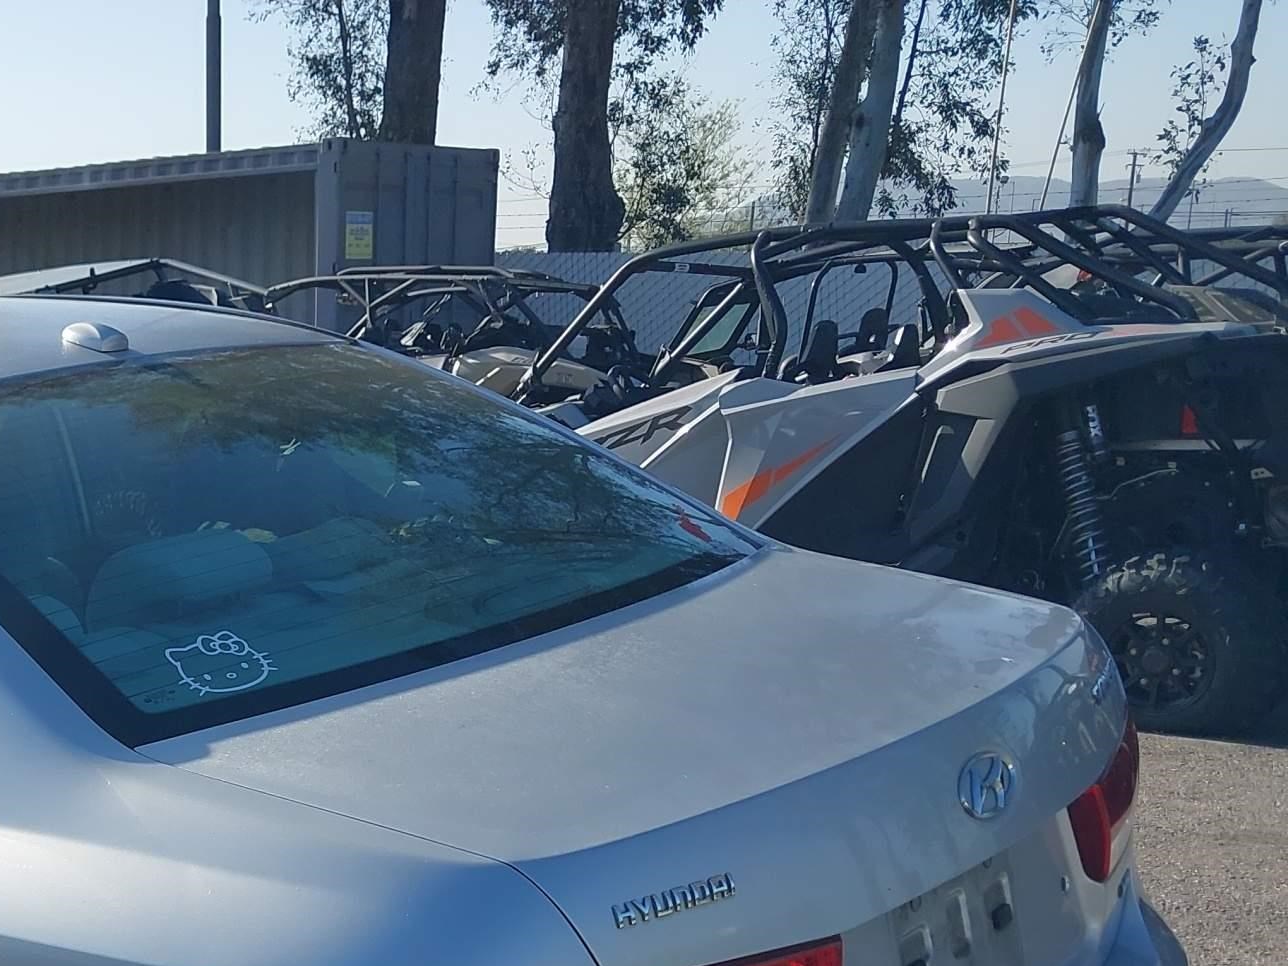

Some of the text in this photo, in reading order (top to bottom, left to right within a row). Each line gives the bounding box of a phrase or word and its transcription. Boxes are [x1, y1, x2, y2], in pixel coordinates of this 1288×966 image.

[1000, 330, 1101, 355] PRO
[591, 404, 693, 450] ZR
[611, 871, 737, 929] HYUNDAI
